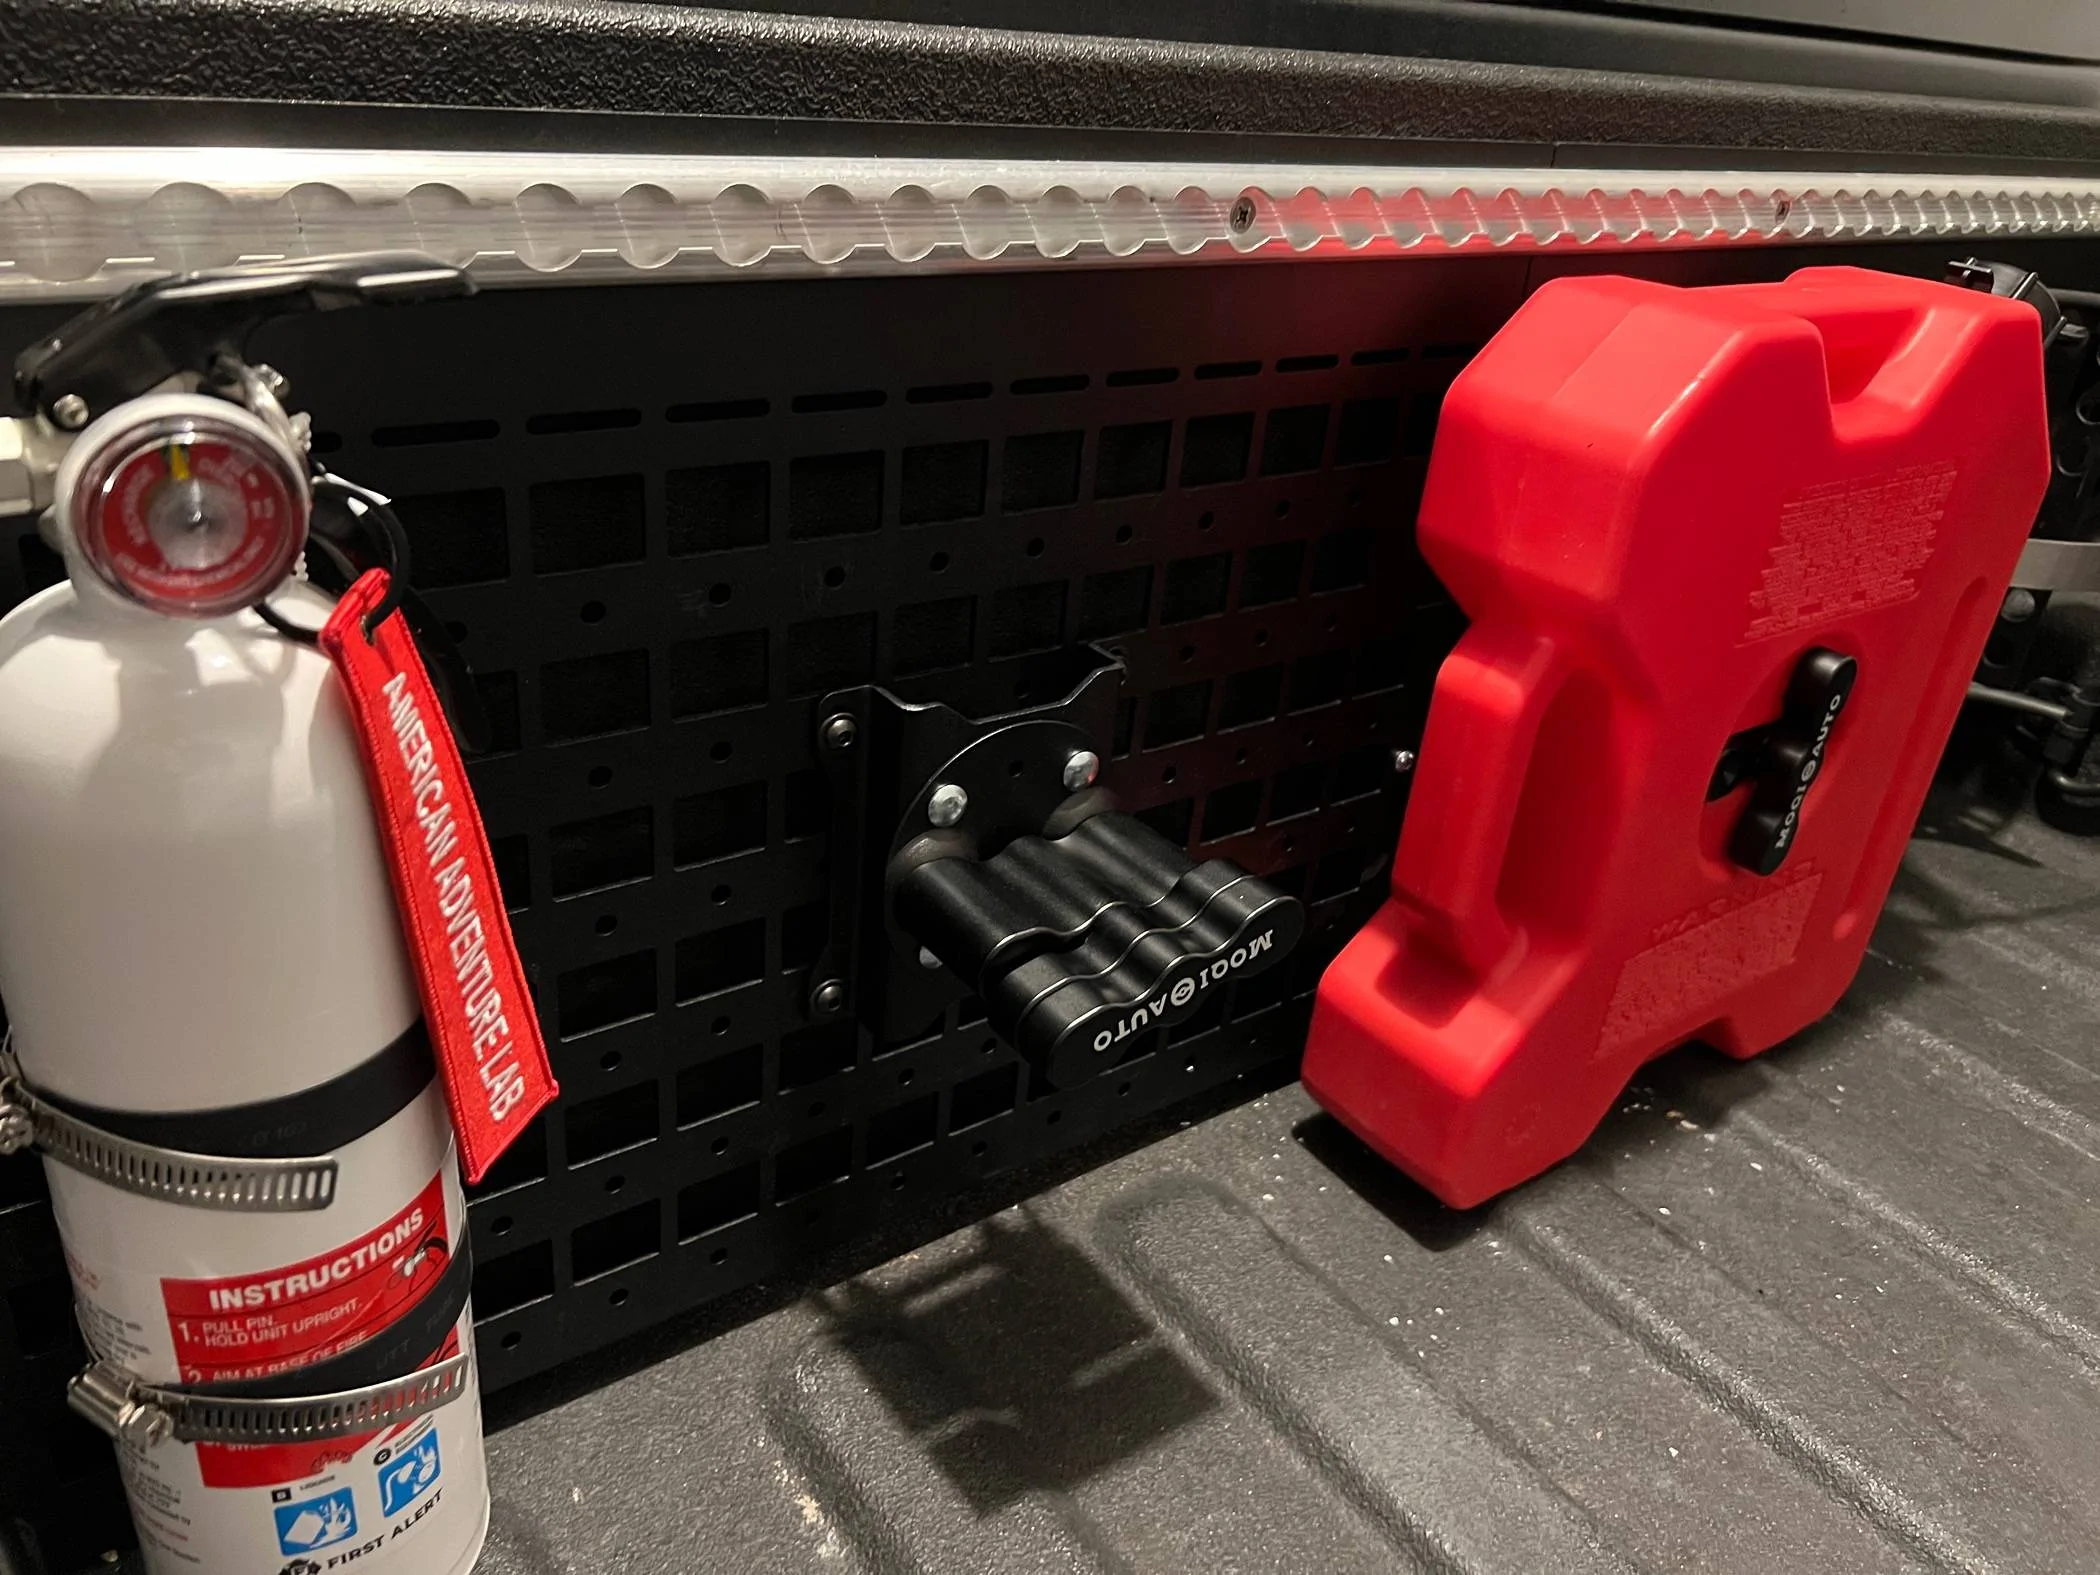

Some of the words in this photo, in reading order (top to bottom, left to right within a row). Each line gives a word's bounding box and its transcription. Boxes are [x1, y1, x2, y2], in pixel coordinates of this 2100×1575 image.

[1812, 694, 1841, 757] AUTO
[382, 672, 458, 867] AMERICAN
[434, 857, 509, 1061] ADVENTURE
[479, 1040, 525, 1121] LAB
[1200, 929, 1274, 990] MOQI
[1093, 993, 1167, 1052] AUTO
[209, 1208, 424, 1312] INSTRUCTIONS
[177, 1321, 200, 1344] 1.
[202, 1319, 243, 1335] PULL
[205, 1332, 249, 1348] HOLD
[252, 1324, 288, 1344] UNIT
[213, 1368, 241, 1382] AIM
[327, 1534, 385, 1570] FIRST
[391, 1487, 444, 1540] ALERT
